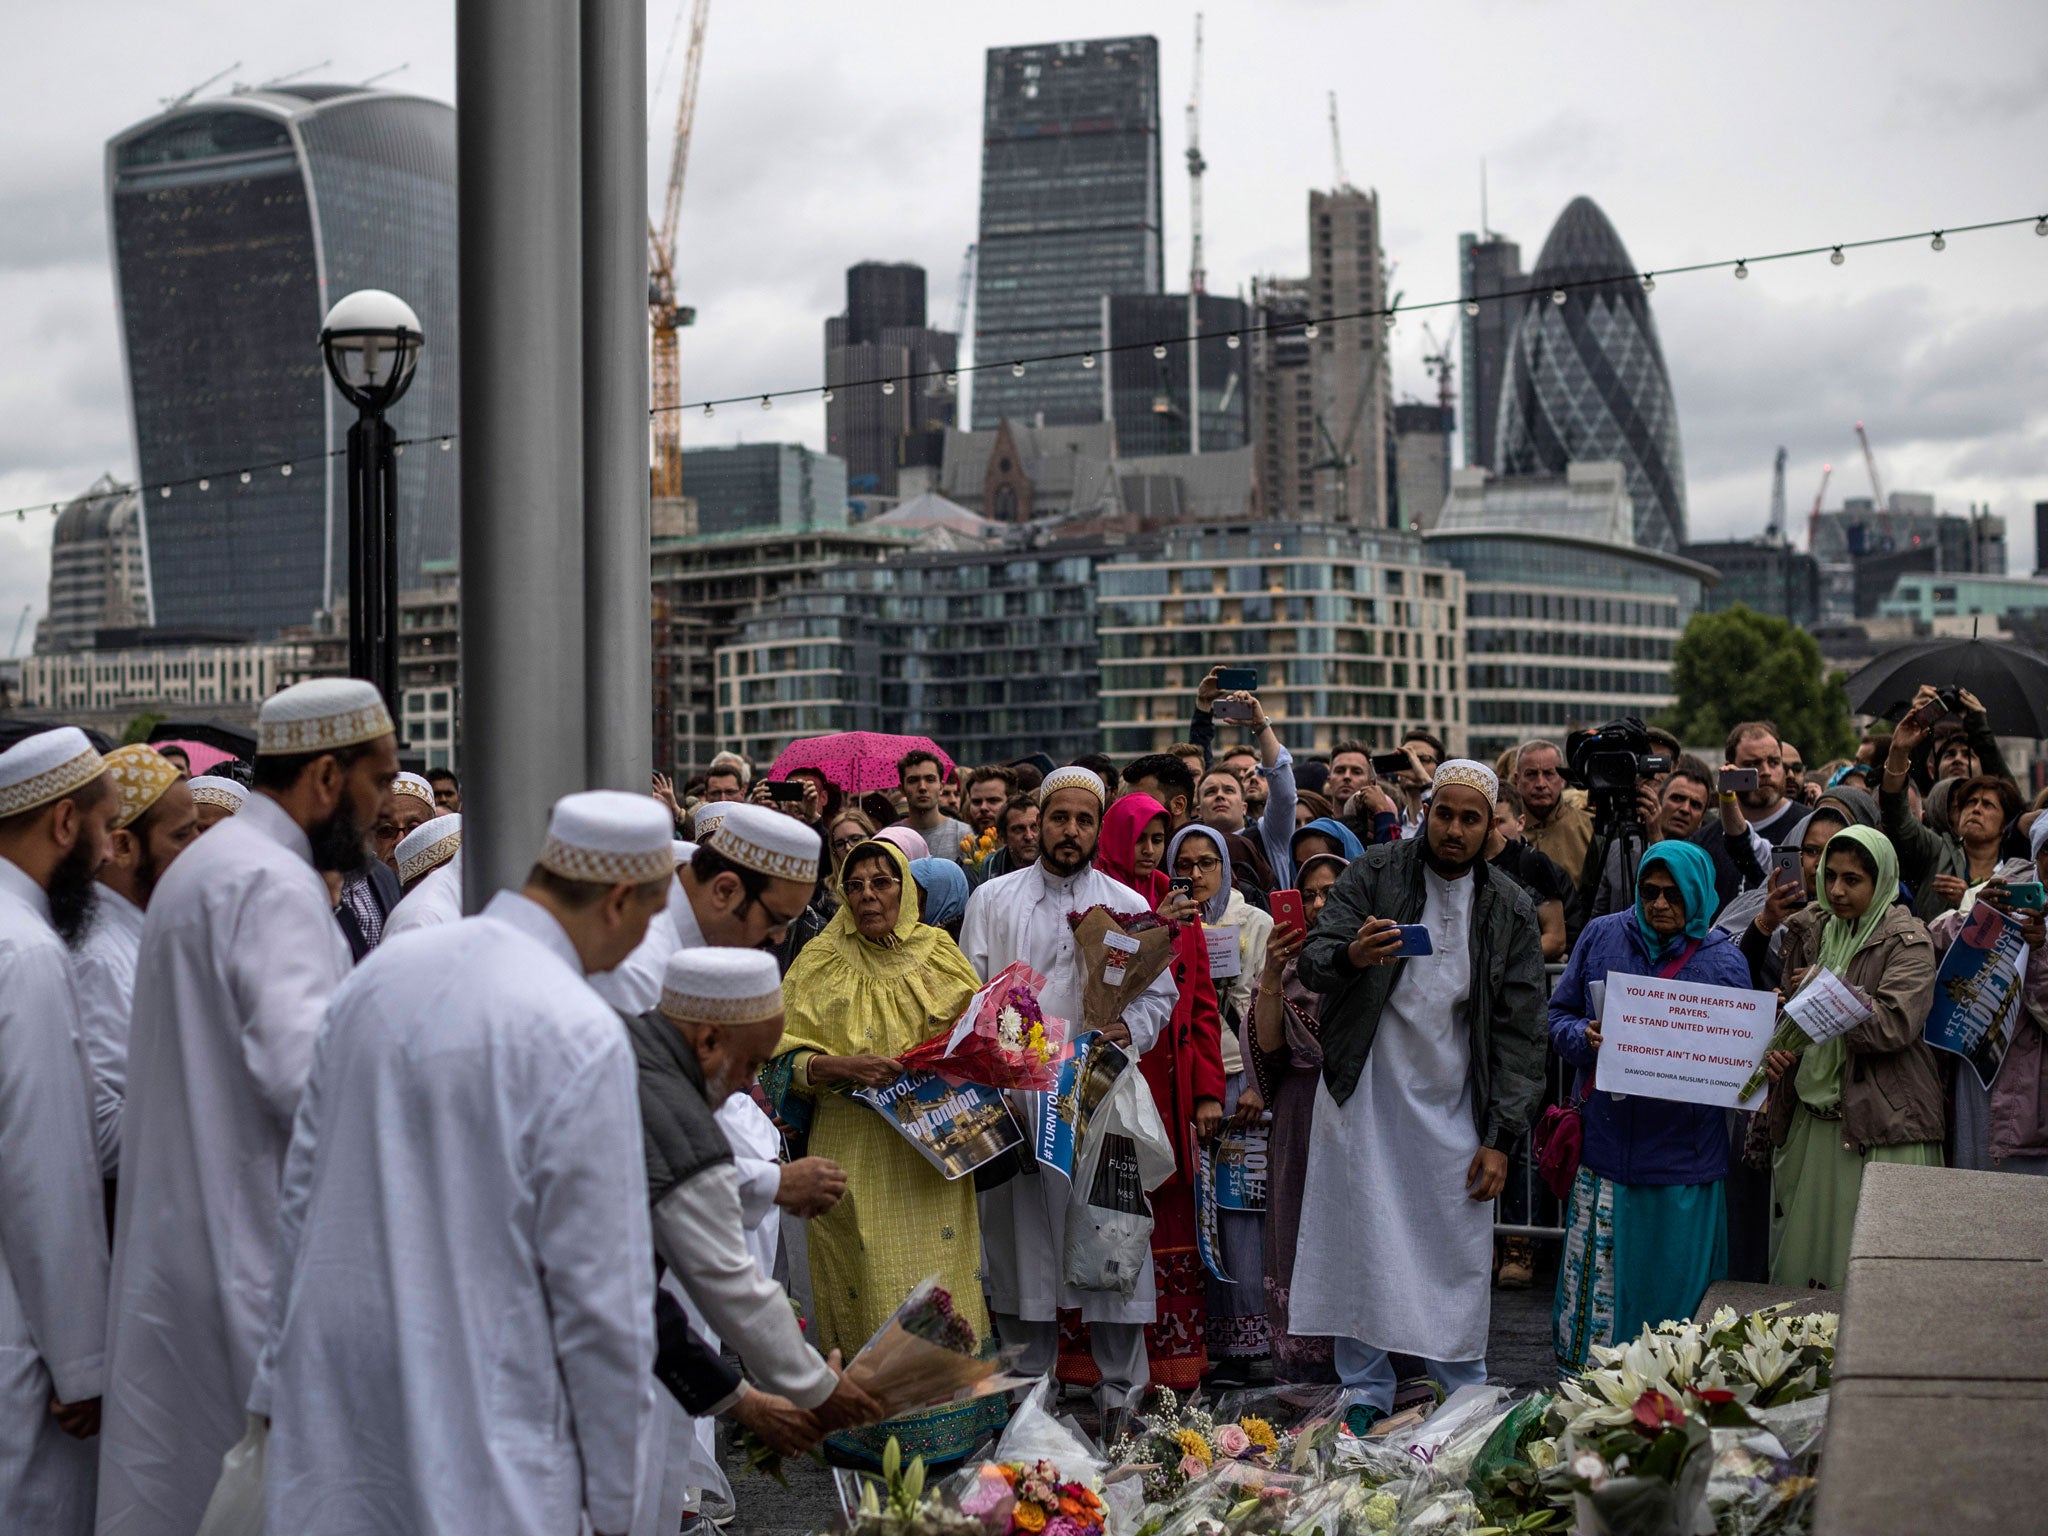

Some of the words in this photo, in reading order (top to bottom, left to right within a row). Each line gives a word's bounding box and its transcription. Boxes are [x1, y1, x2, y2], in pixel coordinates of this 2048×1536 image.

[1944, 996, 1974, 1038] #ISIS
[1967, 961, 1995, 993] WILL
[1990, 924, 2015, 956] LOSE
[1626, 986, 1646, 997] YOU
[1647, 989, 1666, 1000] ARE
[1667, 992, 1677, 1001] IN
[1678, 993, 1699, 1004] OUR
[1700, 996, 1735, 1009] HEARTS
[1736, 1001, 1757, 1011] AND
[1668, 1006, 1710, 1019] PRAYERS.
[1957, 973, 2011, 1052] #LOVE
[1622, 1014, 1637, 1024] WE
[1639, 1016, 1669, 1028] STAND
[1670, 1021, 1704, 1032] UNITED
[1705, 1025, 1730, 1036] WITH
[1731, 1029, 1754, 1040] YOU.
[1616, 1043, 1665, 1057] TERRORIST
[1665, 1050, 1691, 1060] AIN'T
[1692, 1052, 1707, 1062] NO
[1708, 1055, 1753, 1069] MUSLIM'S
[1624, 1067, 1656, 1077] DAWOODI
[1656, 1072, 1678, 1081] BOHRA
[1678, 1075, 1709, 1085] MUSLIM'S
[1709, 1079, 1741, 1089] (LONDON)
[1229, 1152, 1241, 1197] #ISIS
[1243, 1126, 1270, 1200] #LOVE
[1117, 1188, 1135, 1200] M&S
